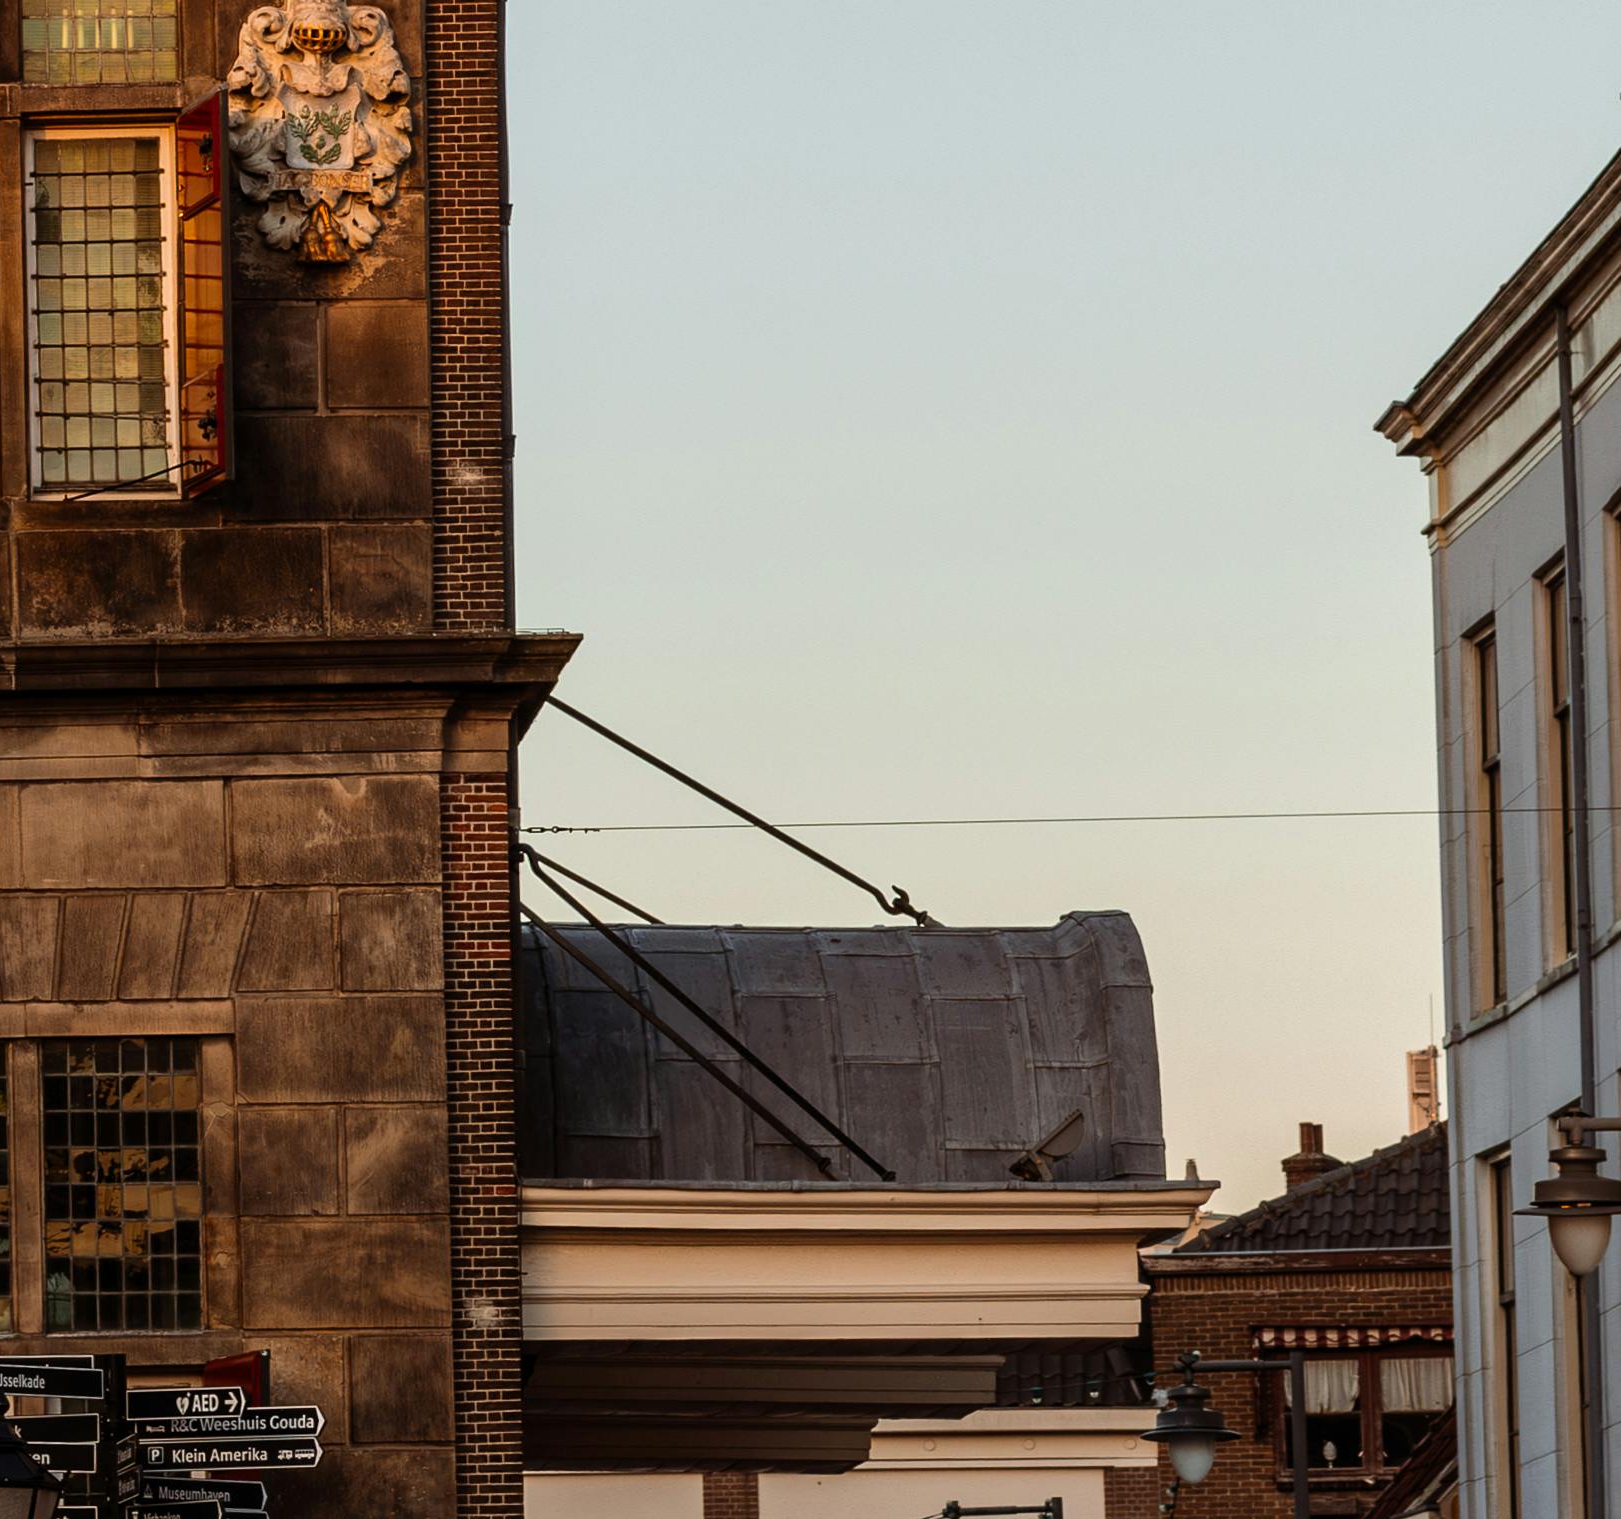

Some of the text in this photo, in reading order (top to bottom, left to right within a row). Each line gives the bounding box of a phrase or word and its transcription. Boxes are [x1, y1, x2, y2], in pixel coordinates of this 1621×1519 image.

[191, 1394, 219, 1413] AED
[170, 1414, 315, 1434] R&C Weeshuis Gouda
[171, 1447, 206, 1464] Klein
[209, 1446, 268, 1462] Amerika
[158, 1485, 231, 1503] Museumhaven
